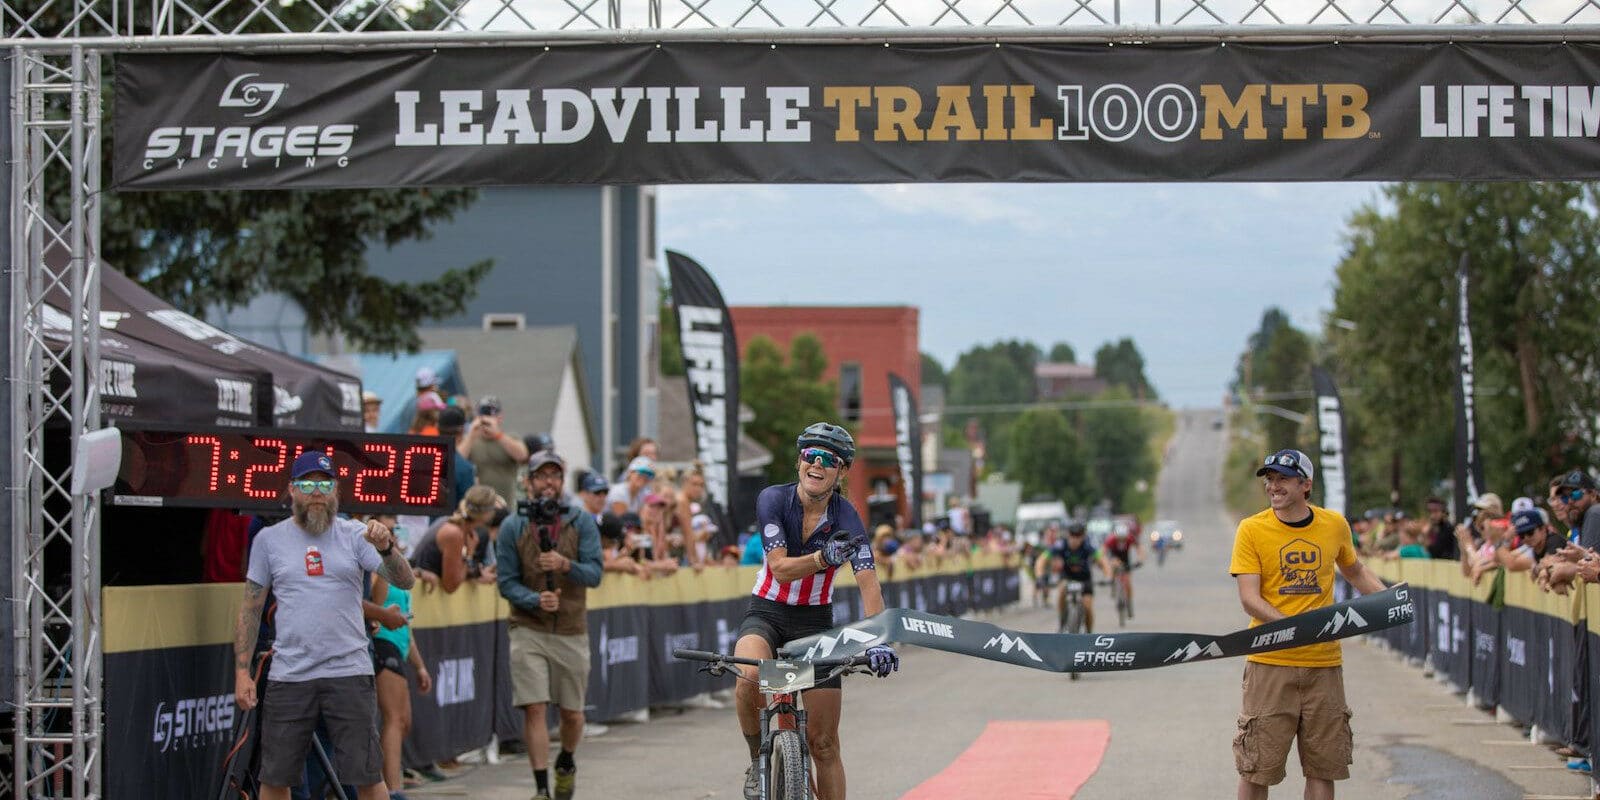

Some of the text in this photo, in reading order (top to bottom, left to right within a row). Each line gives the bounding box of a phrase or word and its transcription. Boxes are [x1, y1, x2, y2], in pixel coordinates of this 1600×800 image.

[395, 86, 811, 146] LEADVILLE
[1420, 85, 1515, 137] LIFE
[144, 124, 355, 158] STAGES
[142, 156, 349, 170] CYCLING
[678, 304, 725, 395] LIFE
[188, 437, 442, 504] 7:2:20
[1285, 551, 1317, 564] GU
[901, 616, 955, 639] LIFE TIME
[1250, 626, 1297, 648] LIFE TIME
[1074, 652, 1136, 662] STAGES
[785, 672, 797, 683] 9
[174, 693, 235, 737] STAGES
